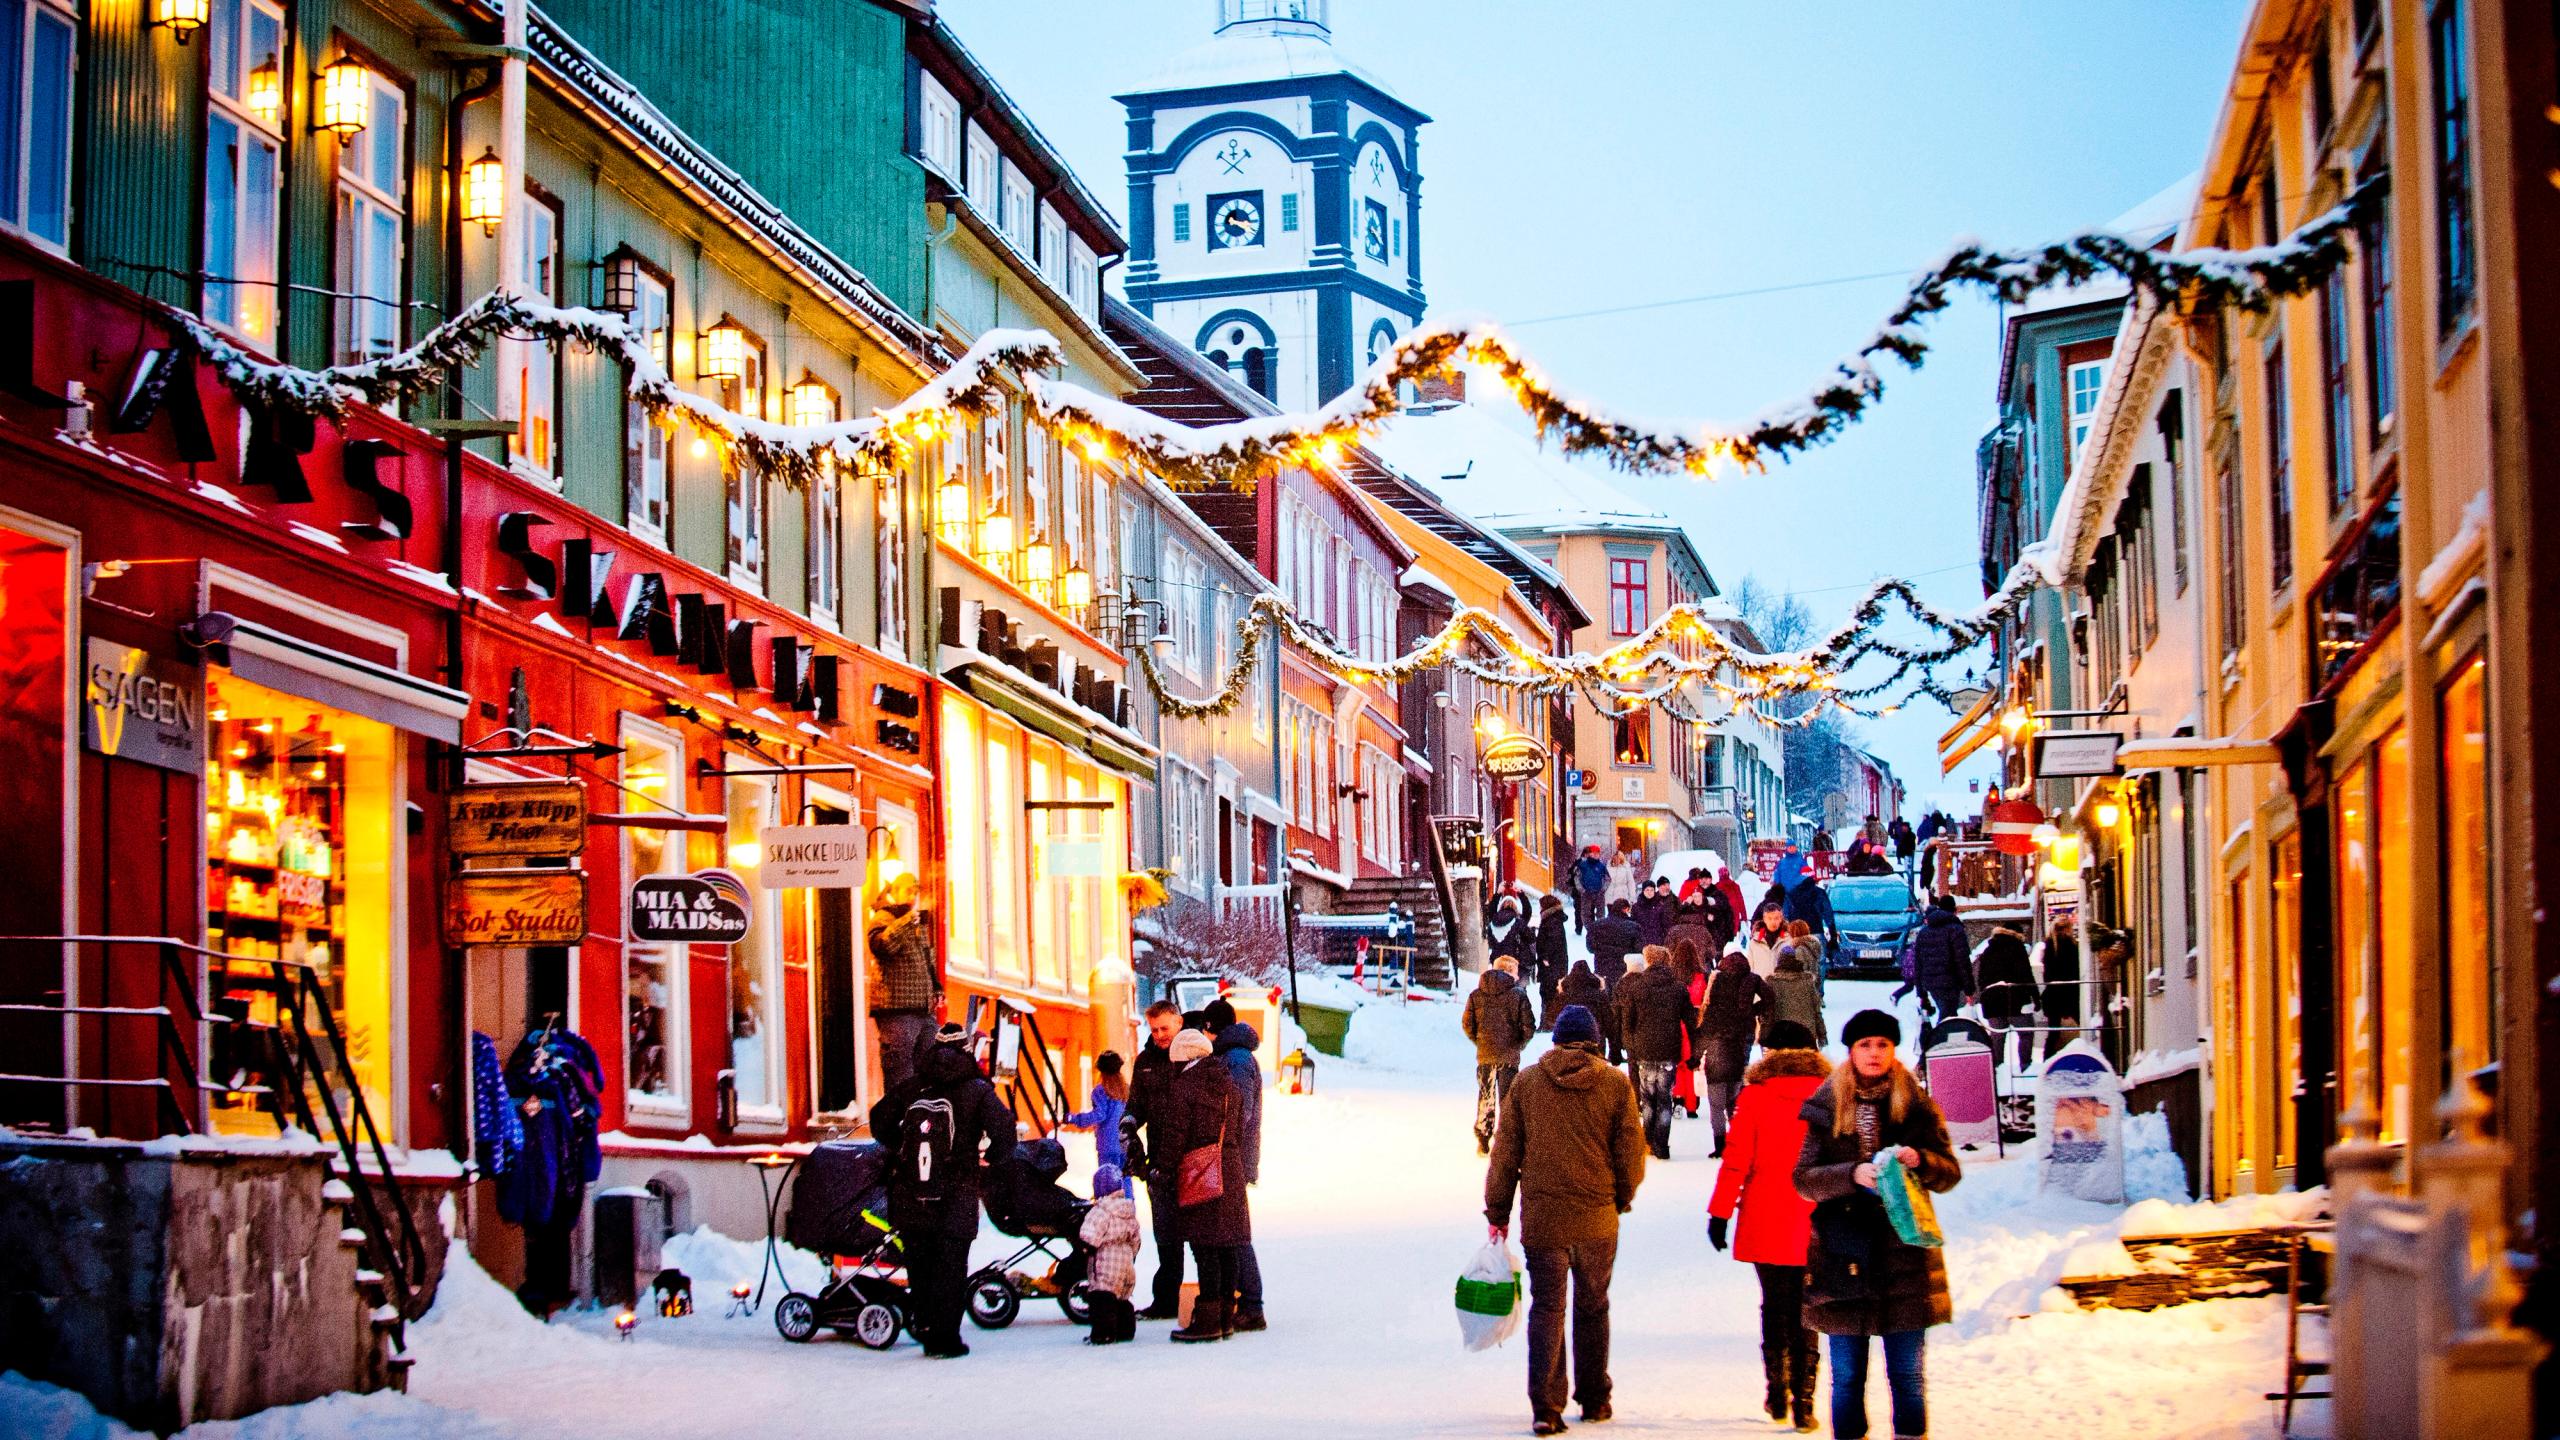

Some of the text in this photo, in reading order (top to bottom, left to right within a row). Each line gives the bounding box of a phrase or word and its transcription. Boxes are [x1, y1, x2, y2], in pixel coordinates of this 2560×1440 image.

[1569, 773, 1578, 785] P
[769, 843, 828, 863] SKANCKE
[636, 890, 716, 910] MIA &
[501, 907, 580, 932] Studio
